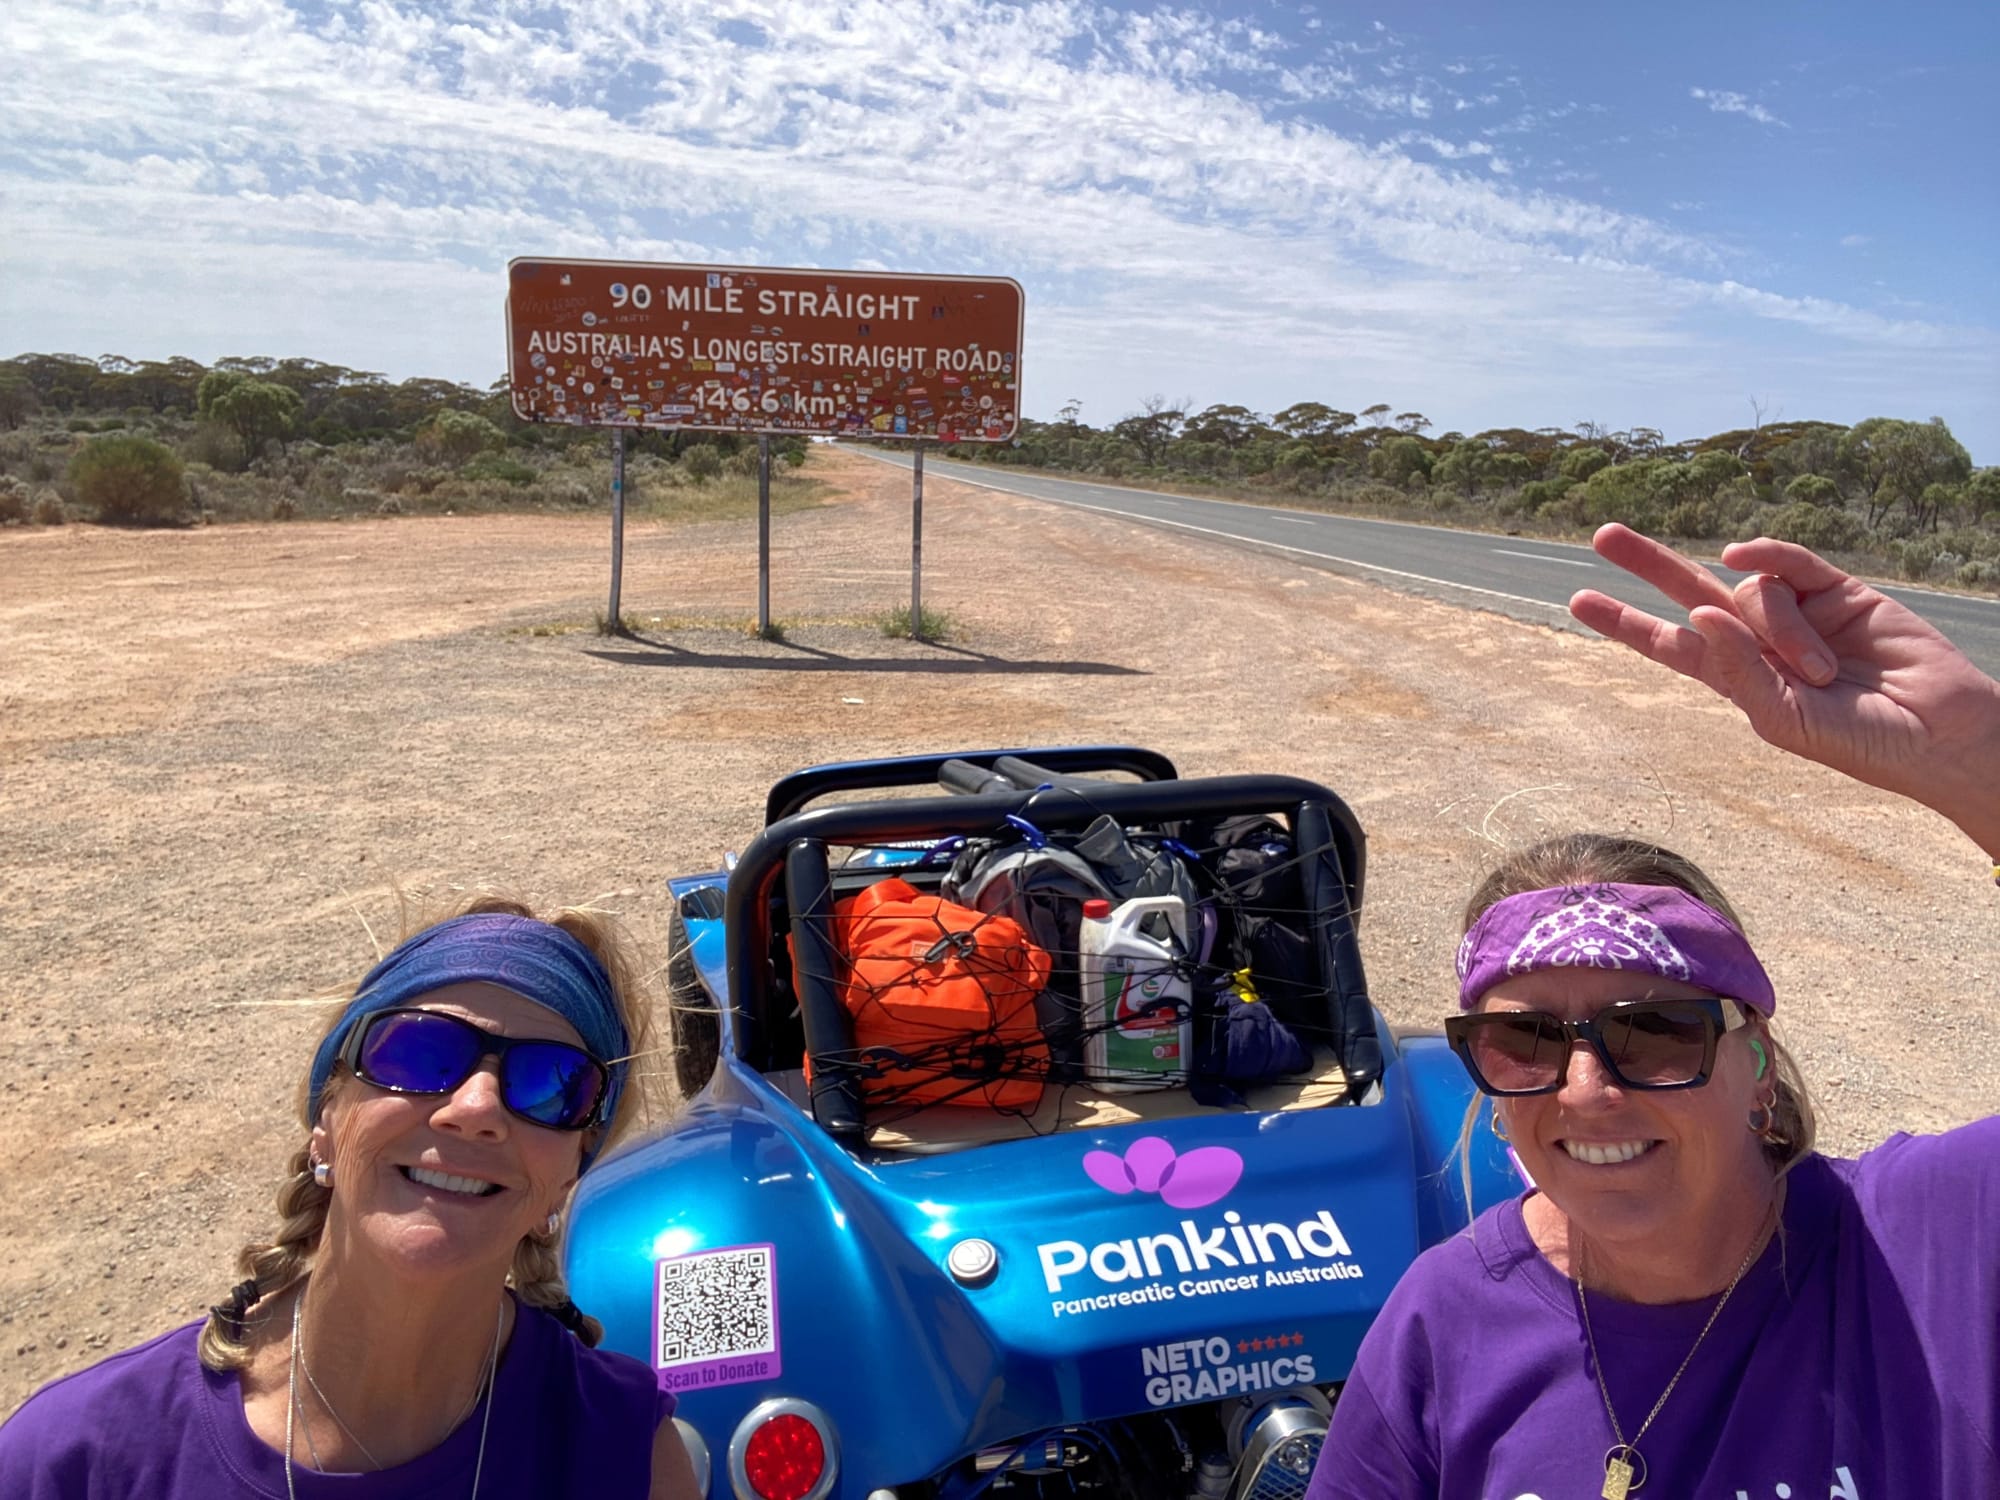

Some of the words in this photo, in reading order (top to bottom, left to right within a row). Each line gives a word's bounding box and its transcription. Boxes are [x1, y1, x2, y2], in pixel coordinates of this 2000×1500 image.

[609, 282, 652, 310] 90
[666, 286, 744, 314] MILE
[757, 289, 920, 321] STRAIGHT
[528, 330, 685, 360] AUSTRALIA'S
[693, 337, 803, 365] LONGEST
[810, 343, 927, 370] STRAIGHT
[935, 348, 1003, 373] ROAD
[695, 385, 780, 413] 146.6
[794, 390, 834, 416] km
[1037, 1210, 1353, 1293] Pankind
[1051, 1281, 1177, 1318] Pancreatic
[1177, 1274, 1259, 1298] Cancer
[1264, 1261, 1364, 1288] Australia
[664, 1370, 700, 1390] Scan
[702, 1367, 717, 1384] to
[719, 1361, 769, 1382] Donate
[1141, 1336, 1231, 1376] NETO
[1145, 1354, 1317, 1407] GRAPHICS
